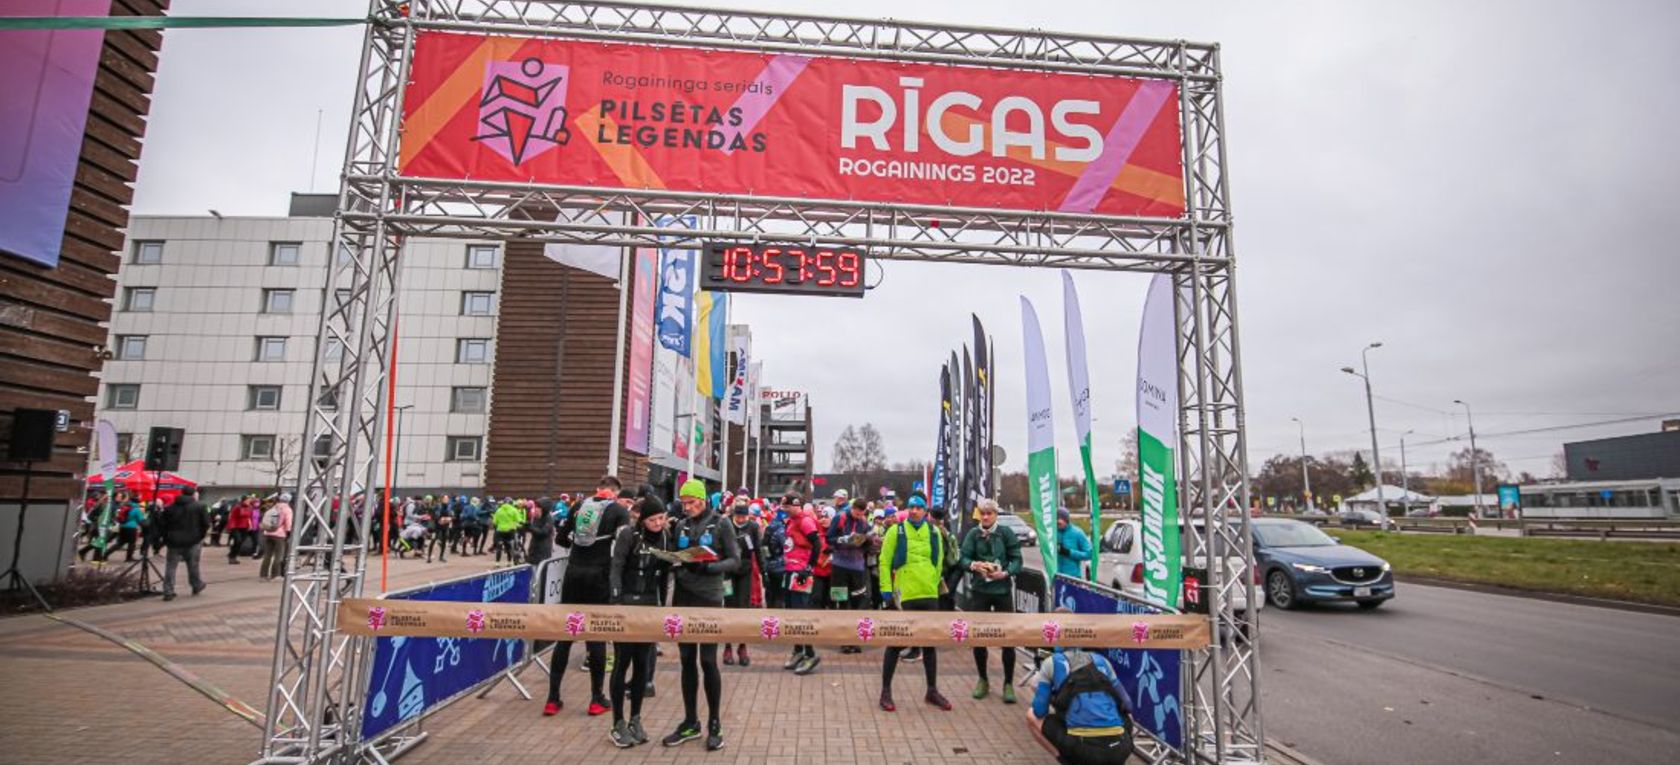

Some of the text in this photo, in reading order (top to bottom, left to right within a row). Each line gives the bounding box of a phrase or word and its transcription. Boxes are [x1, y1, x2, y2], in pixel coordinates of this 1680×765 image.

[602, 71, 708, 92] Rogaininga
[600, 99, 744, 126] PILSĒTAS
[840, 77, 1104, 163] RĪGAS
[838, 157, 1036, 186] ROGAININGS 2022
[723, 247, 858, 286] 10:57:59
